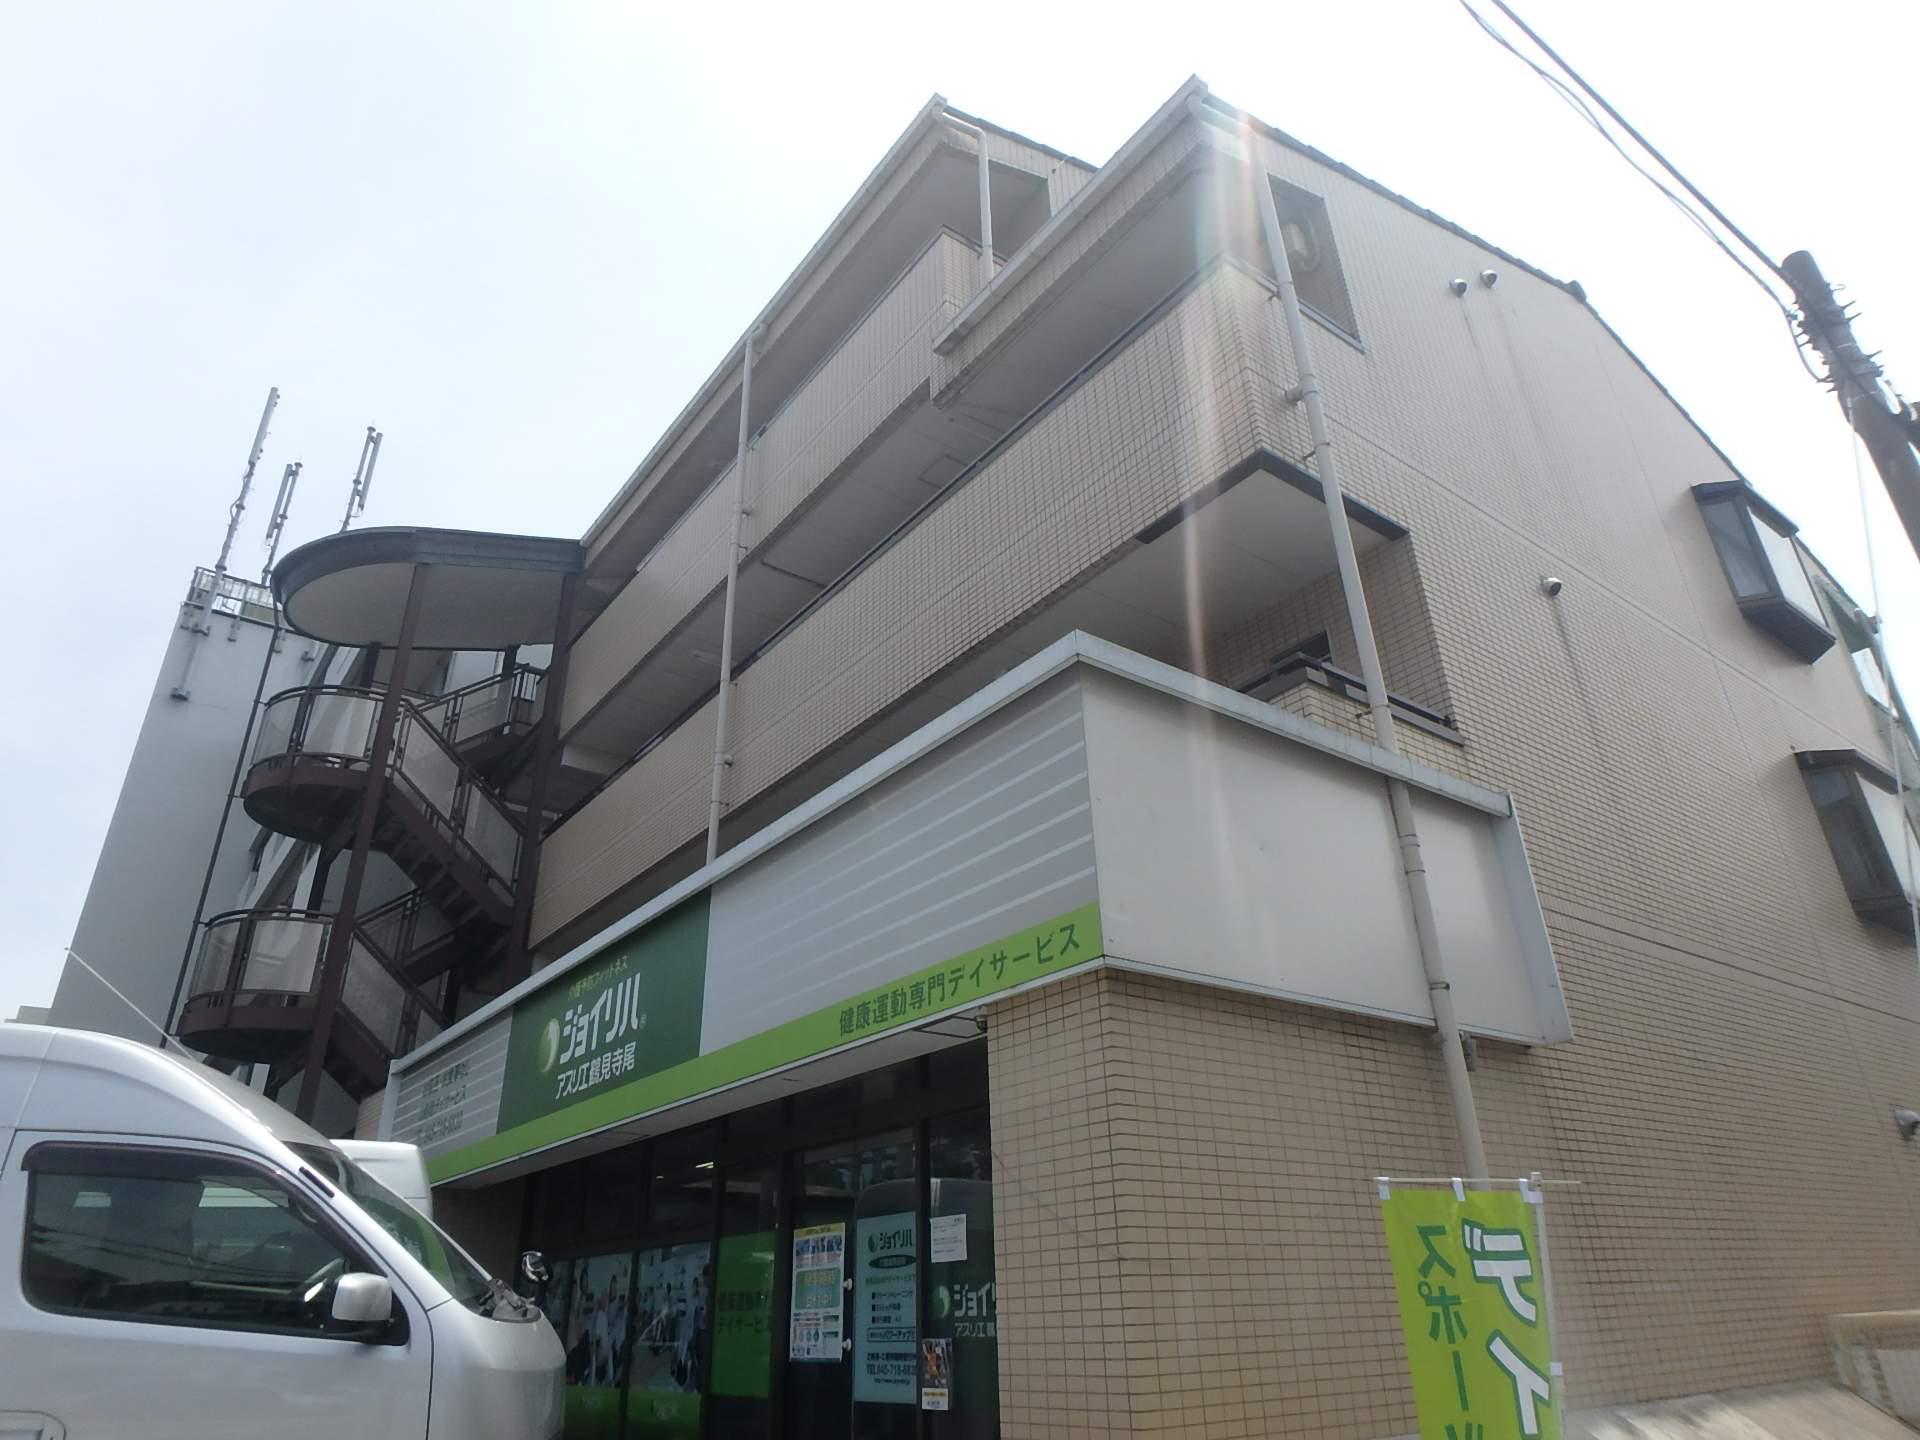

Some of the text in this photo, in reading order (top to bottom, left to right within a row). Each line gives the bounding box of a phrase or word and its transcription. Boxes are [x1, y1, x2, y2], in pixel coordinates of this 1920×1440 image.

[839, 923, 1080, 1037] 健康運動専門デイサービス
[560, 972, 641, 1065] ジョイリハ
[555, 1041, 637, 1099] アスリエ鶴見寺尾
[879, 1229, 912, 1252] ジョイリハ
